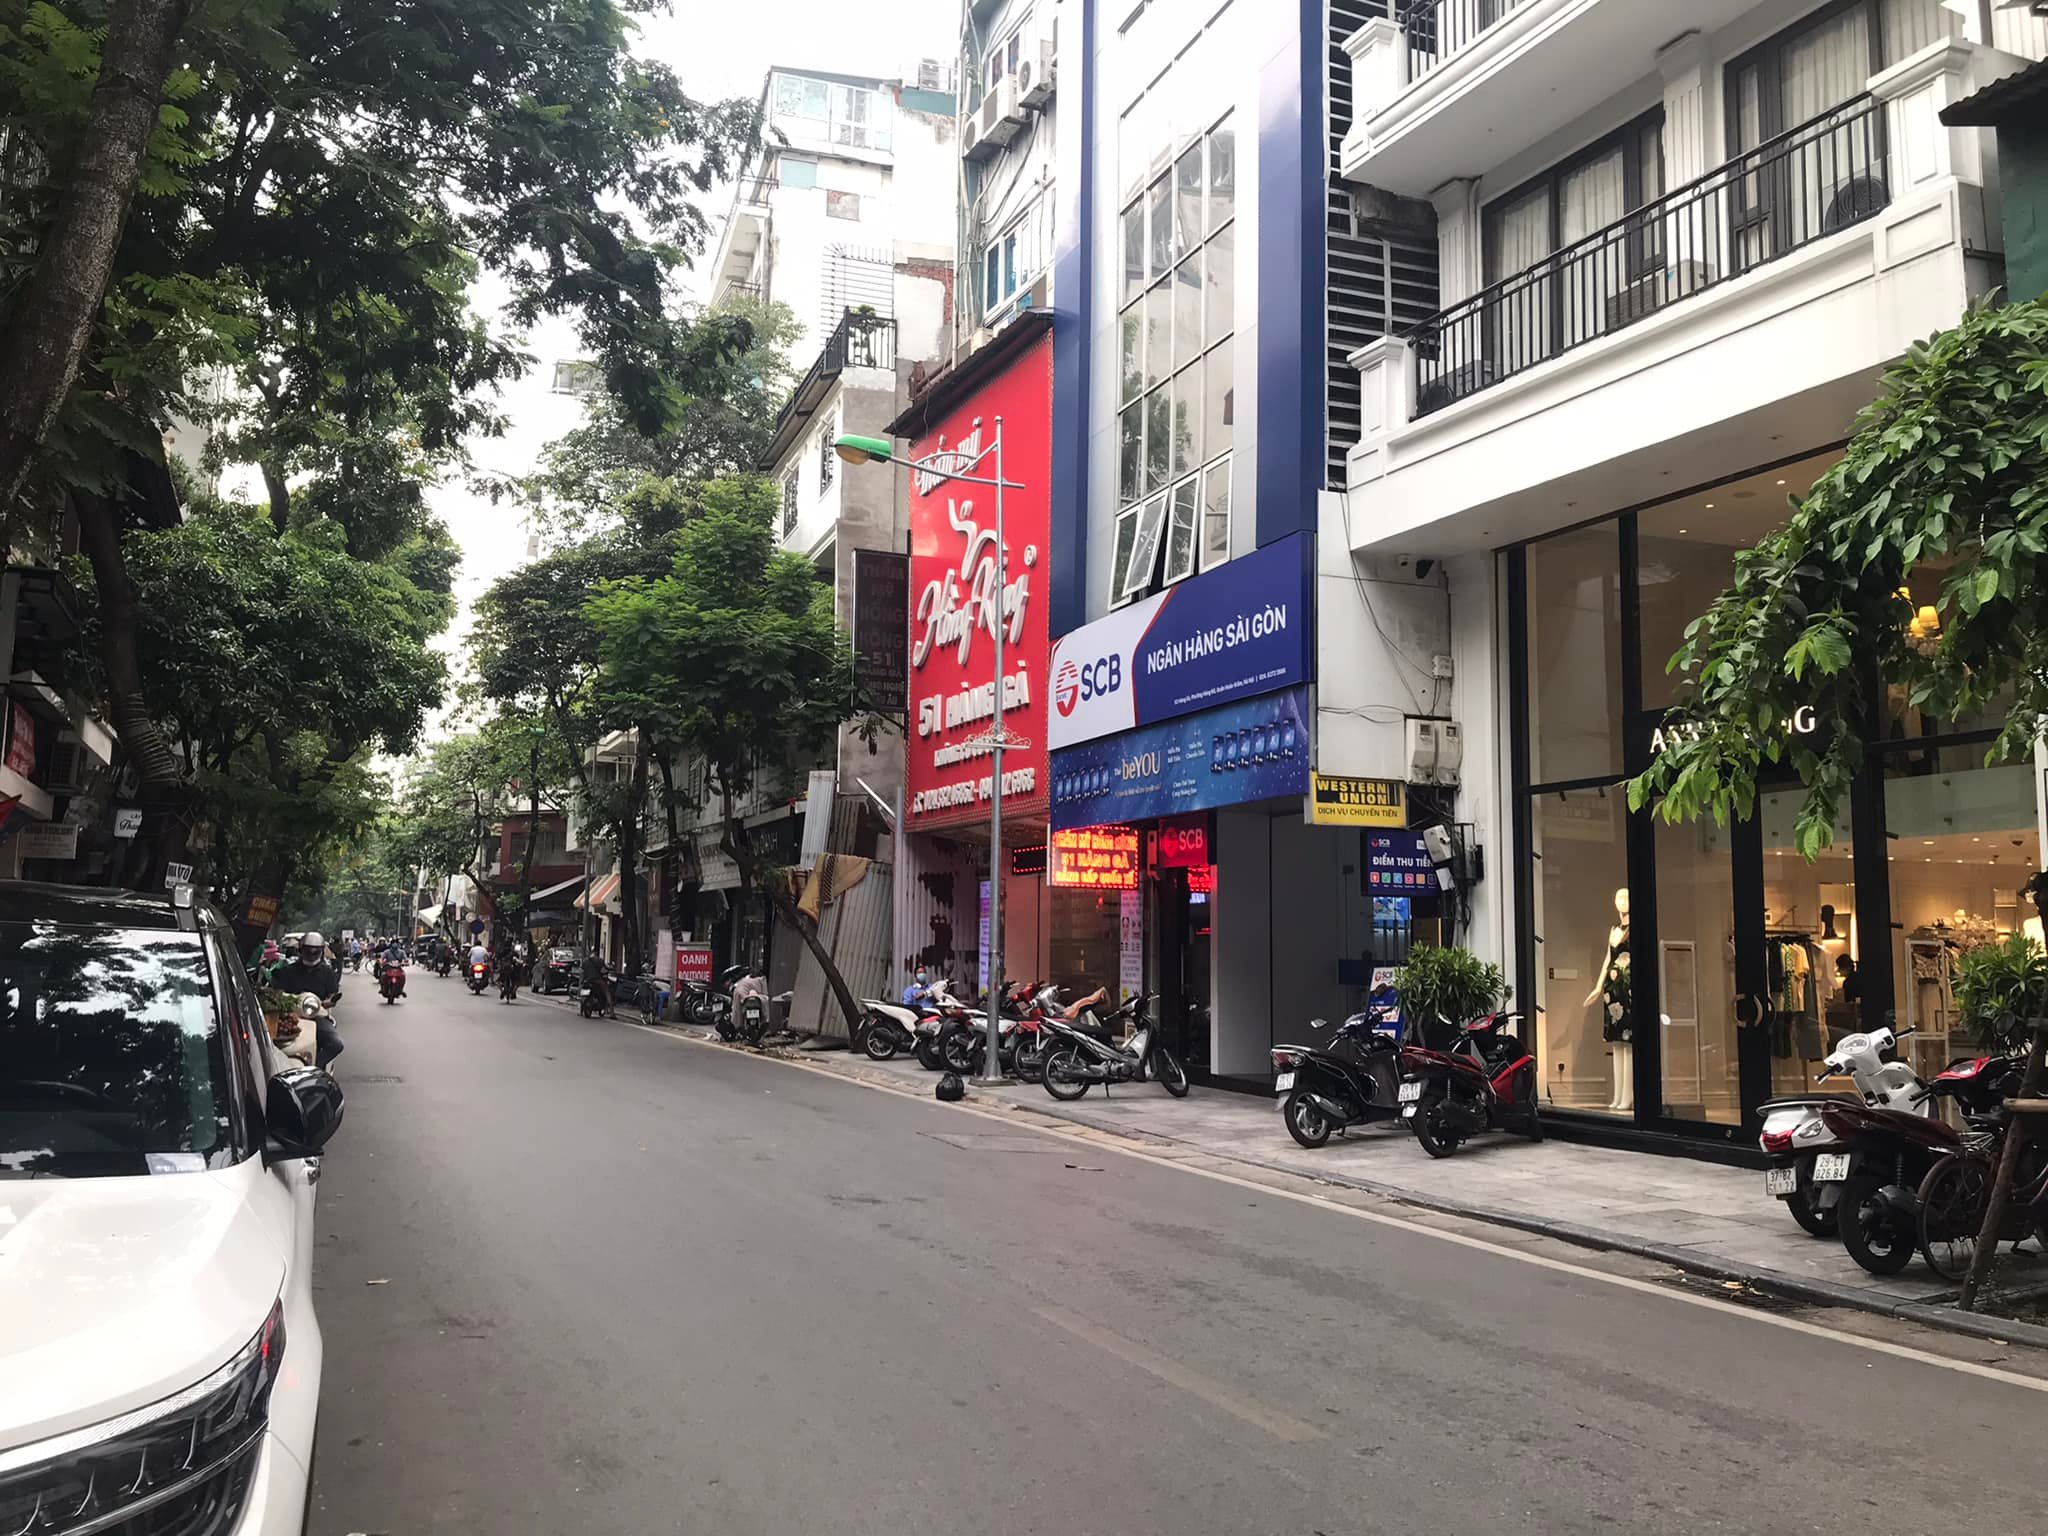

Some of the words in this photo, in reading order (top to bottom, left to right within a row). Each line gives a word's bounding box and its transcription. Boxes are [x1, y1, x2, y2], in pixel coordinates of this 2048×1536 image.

[1147, 640, 1183, 675] NGÂN
[1185, 628, 1224, 662] HÀNG
[1225, 614, 1250, 648] SÀI
[1252, 603, 1287, 639] GÒN
[1080, 653, 1122, 702] SCB
[918, 694, 942, 737] 51
[946, 681, 995, 729] HÀNG
[1002, 660, 1030, 711] GÀ
[1122, 750, 1161, 780] beYOU
[1317, 779, 1387, 794] WESTERN
[1339, 792, 1387, 805] UNION
[1179, 828, 1204, 851] SCB
[1379, 838, 1391, 848] SCB
[1372, 852, 1395, 866] ĐIỂM
[1396, 857, 1414, 867] THU
[681, 954, 708, 965] OANH
